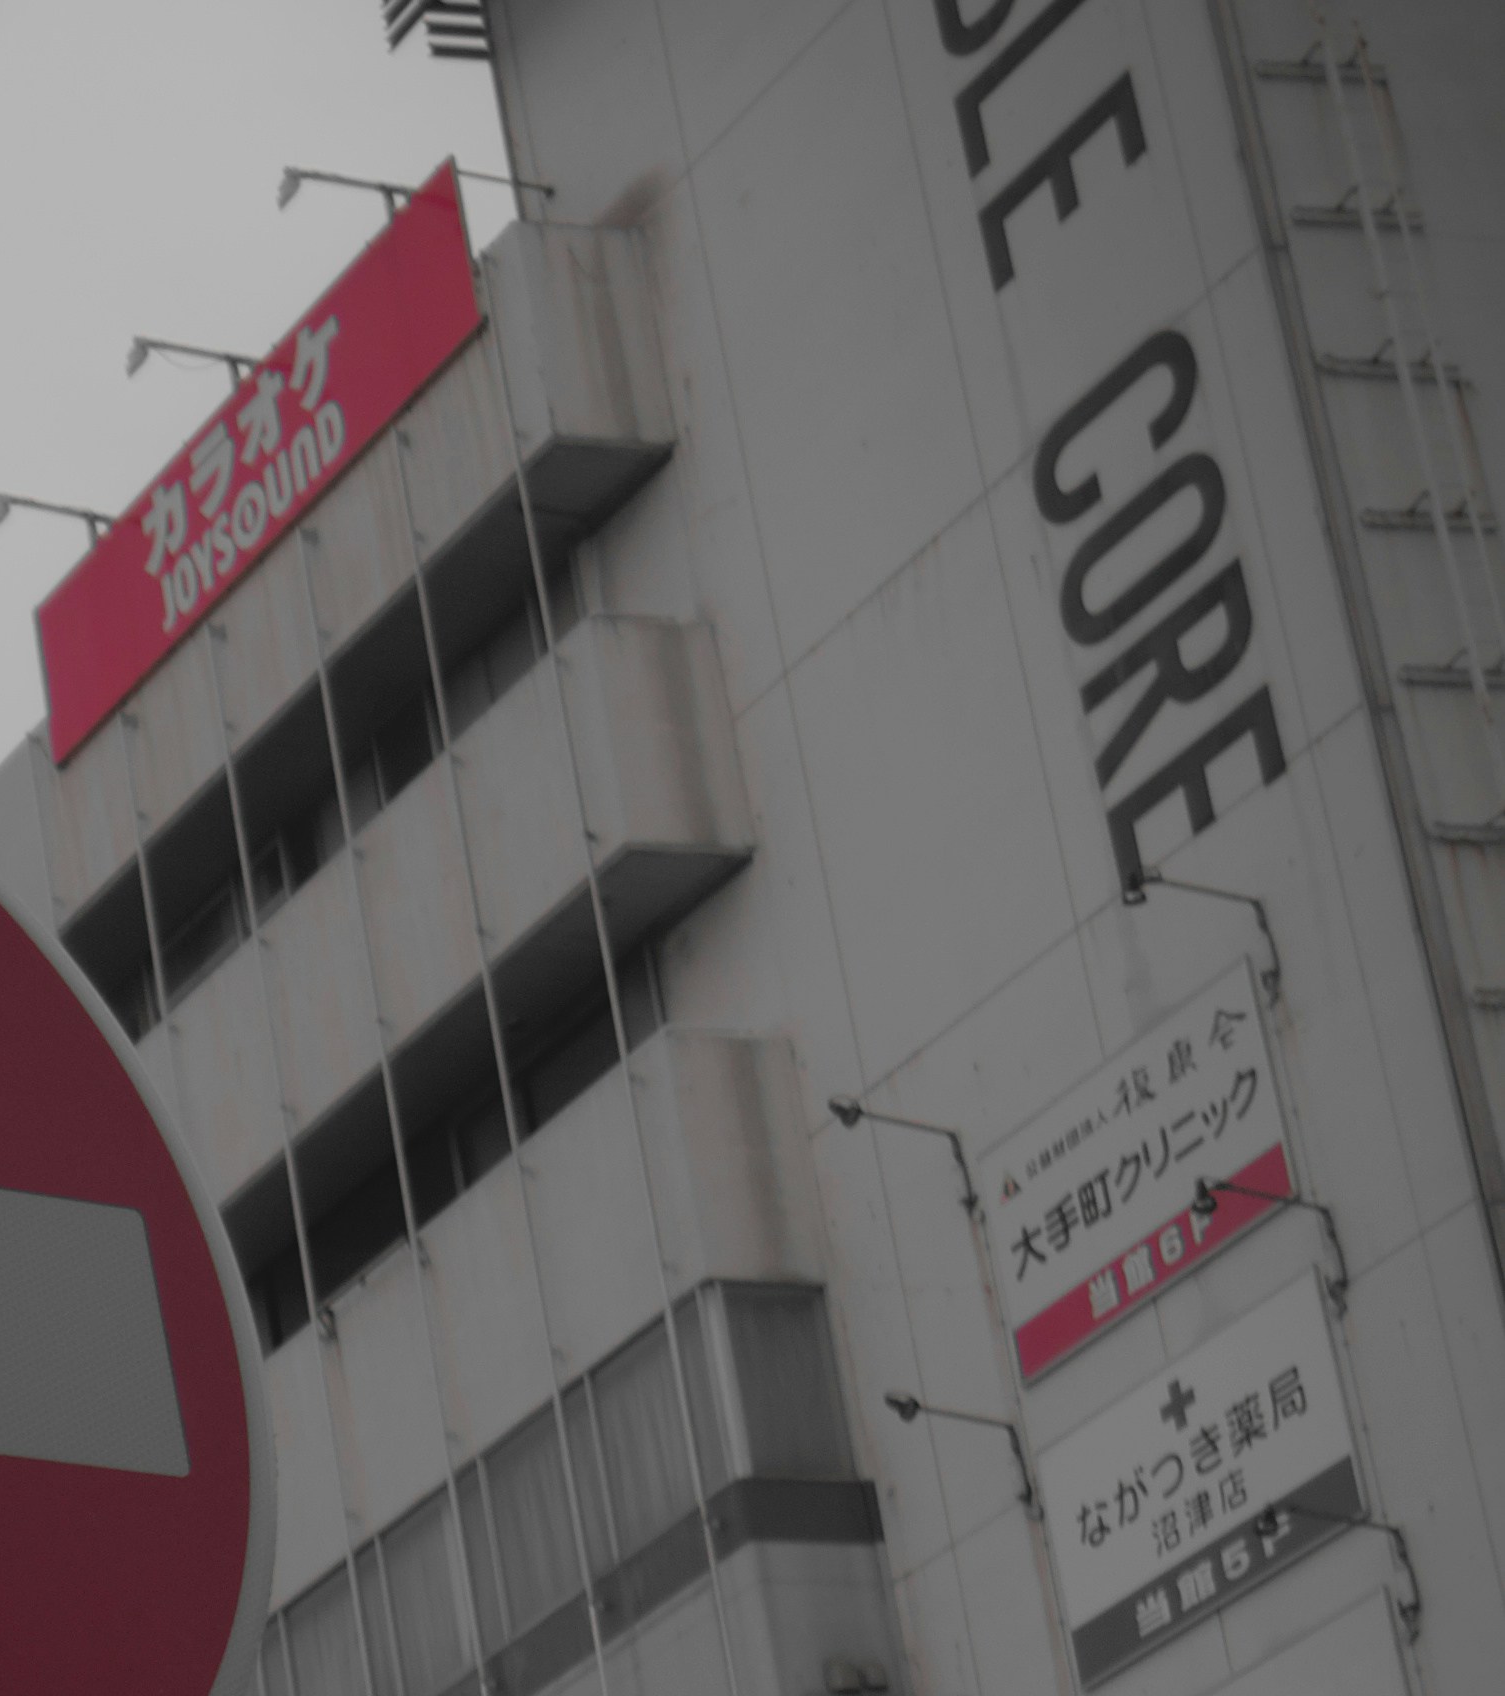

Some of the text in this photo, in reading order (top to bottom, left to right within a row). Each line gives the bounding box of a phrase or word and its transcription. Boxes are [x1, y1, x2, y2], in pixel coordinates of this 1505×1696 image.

[142, 315, 339, 575] カラオケ
[160, 401, 345, 632] JOYSOUND
[1034, 330, 1287, 895] CORE
[1011, 1067, 1258, 1282] 大手町クリニック
[1077, 1365, 1308, 1548] ながつき薬局
[1151, 1467, 1249, 1558] 沼津店
